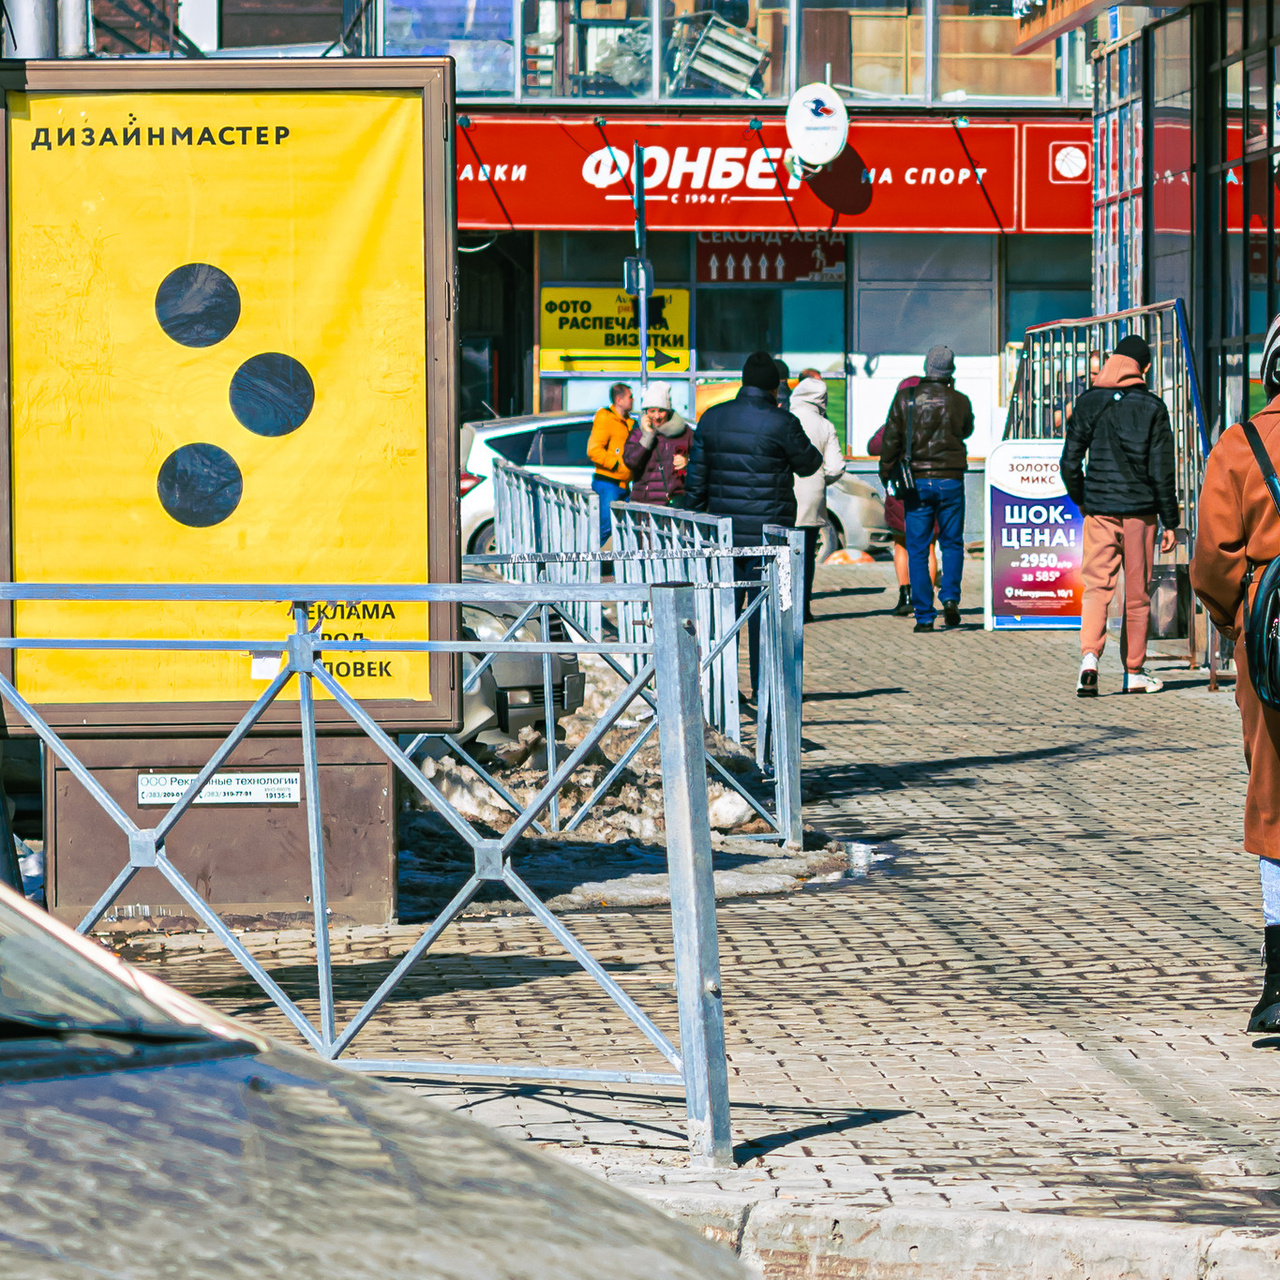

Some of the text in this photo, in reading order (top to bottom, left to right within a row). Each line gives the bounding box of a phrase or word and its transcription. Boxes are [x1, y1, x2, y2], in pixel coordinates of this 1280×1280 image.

[31, 114, 290, 151] ДИЗАЙНМАСТЕР
[458, 164, 527, 181] АВКИ
[861, 168, 893, 184] НА
[905, 167, 987, 184] СПОРТ
[685, 194, 716, 204] 1994
[545, 300, 592, 314] ФОТО
[604, 333, 684, 347] ВИЗТКИ
[1009, 463, 1060, 472] ЗОЛОТО
[1021, 475, 1056, 484] МИКС
[1005, 504, 1072, 525] ШОК-
[1001, 527, 1076, 549] ЦЕНА!
[1020, 553, 1057, 568] 2950
[292, 603, 396, 620] ЕКЛАМА
[323, 661, 392, 677] ЛОВЕК
[140, 776, 167, 787] ООО
[236, 776, 298, 787] технологии
